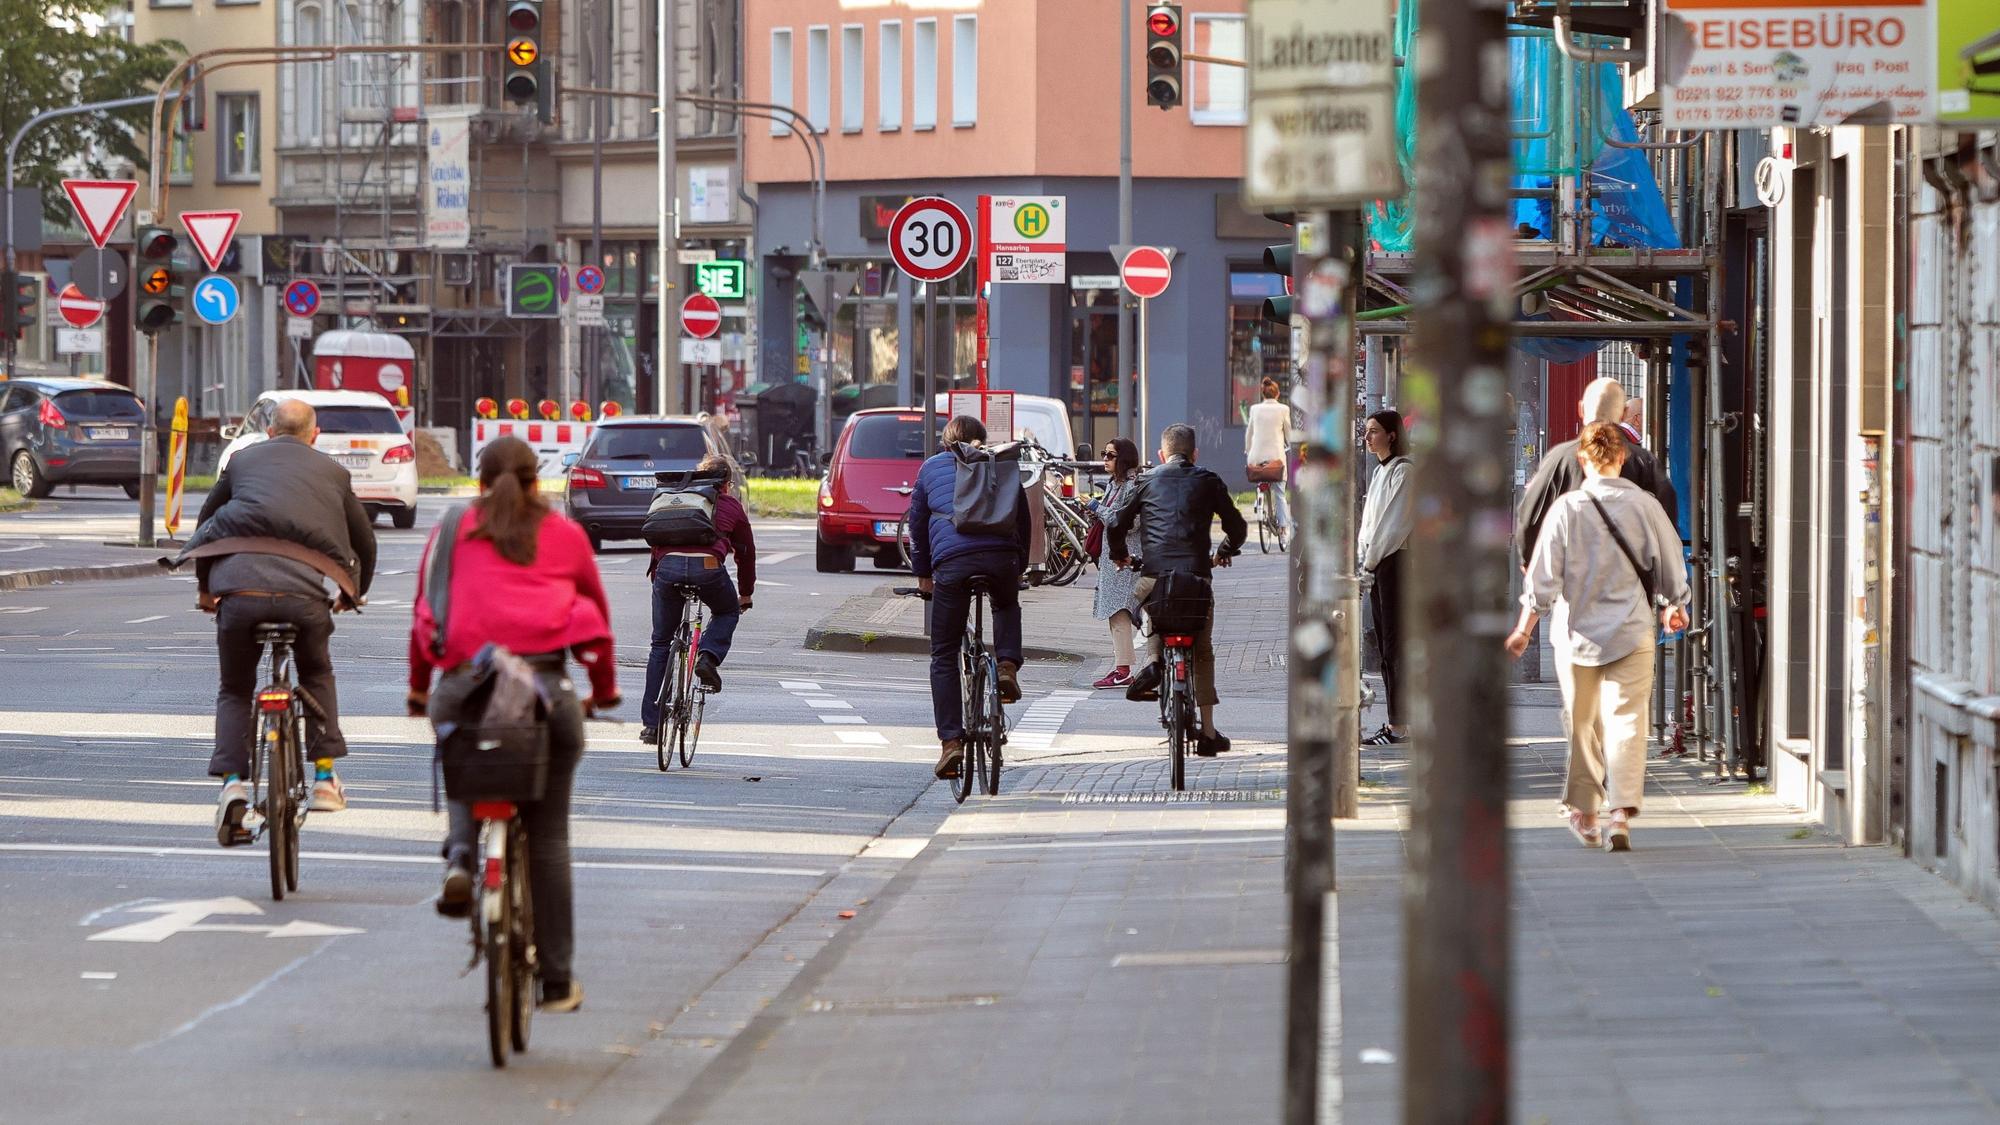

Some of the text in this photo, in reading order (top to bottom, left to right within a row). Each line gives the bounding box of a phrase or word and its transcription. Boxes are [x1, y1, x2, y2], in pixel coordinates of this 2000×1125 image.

[1253, 21, 1387, 70] Ladezone
[1835, 60, 1865, 76] Iraq
[1874, 59, 1910, 73] Post
[1023, 210, 1040, 232] H
[907, 221, 954, 258] 30
[997, 244, 1030, 252] Hansaring
[998, 256, 1013, 265] 127
